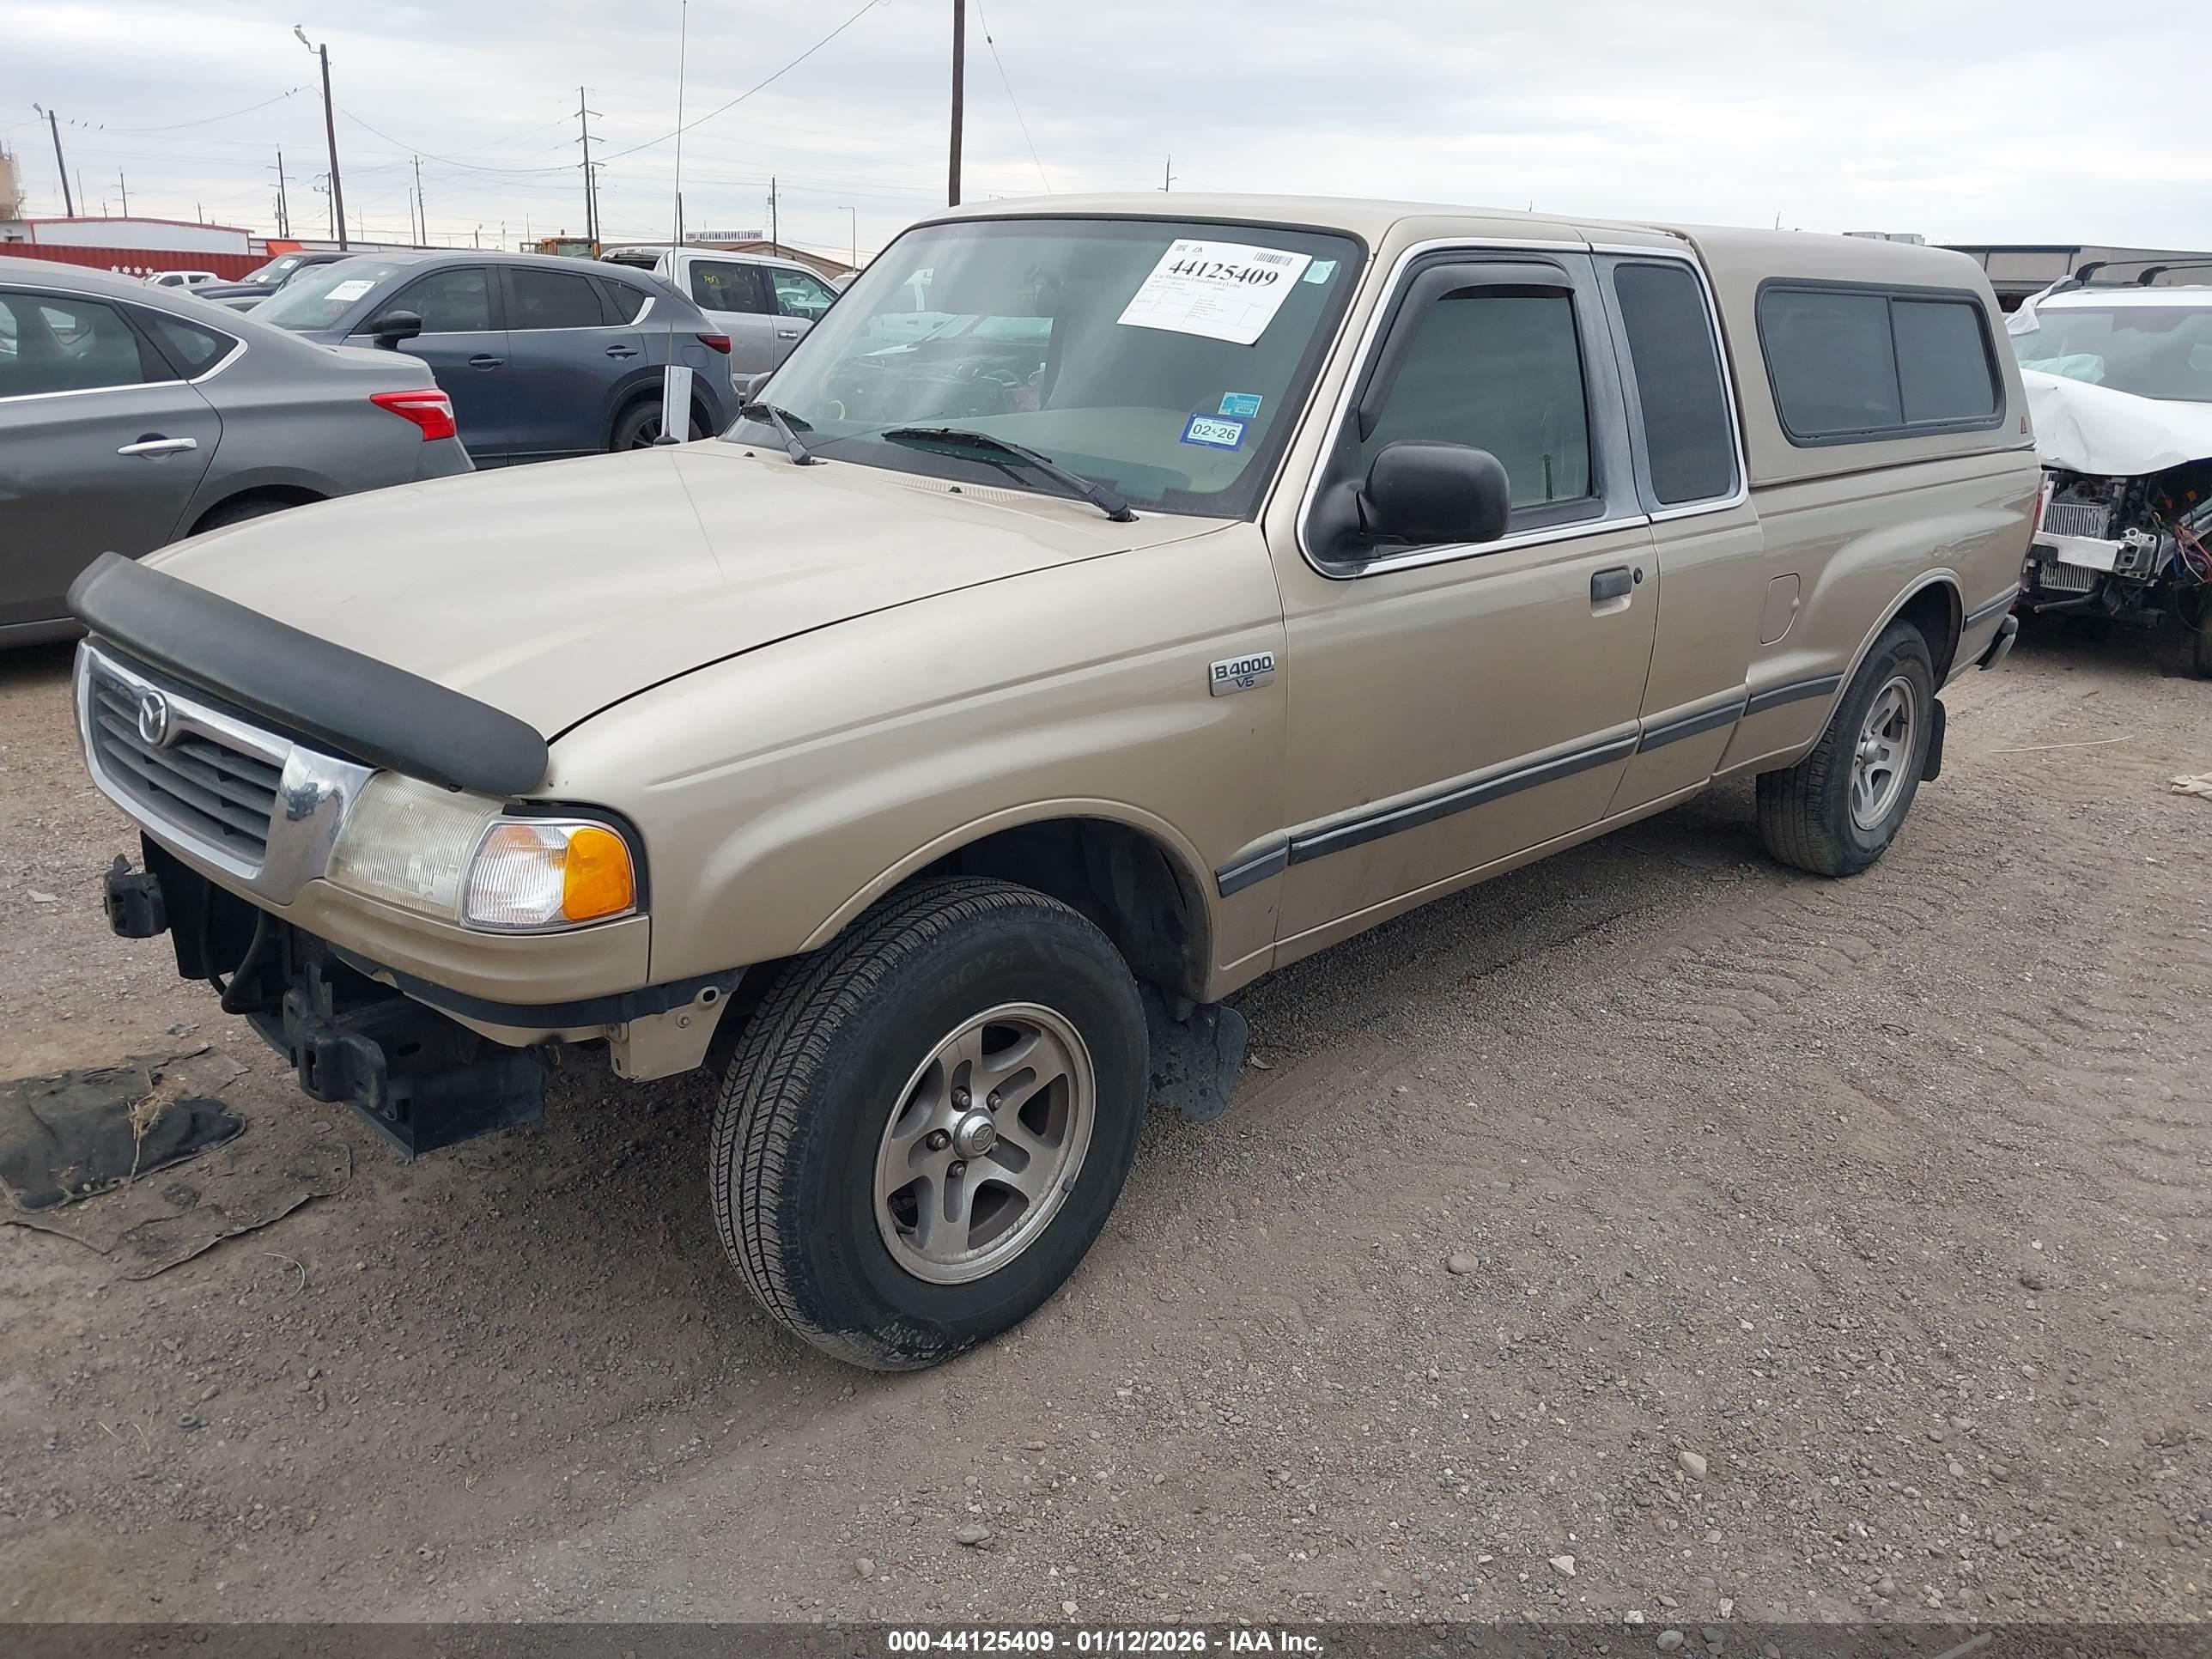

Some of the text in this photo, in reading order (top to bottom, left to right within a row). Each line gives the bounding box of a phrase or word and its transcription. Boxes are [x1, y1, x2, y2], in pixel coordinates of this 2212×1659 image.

[1169, 258, 1279, 287] 44125409
[1215, 656, 1272, 679] B4000
[1235, 676, 1255, 688] V6
